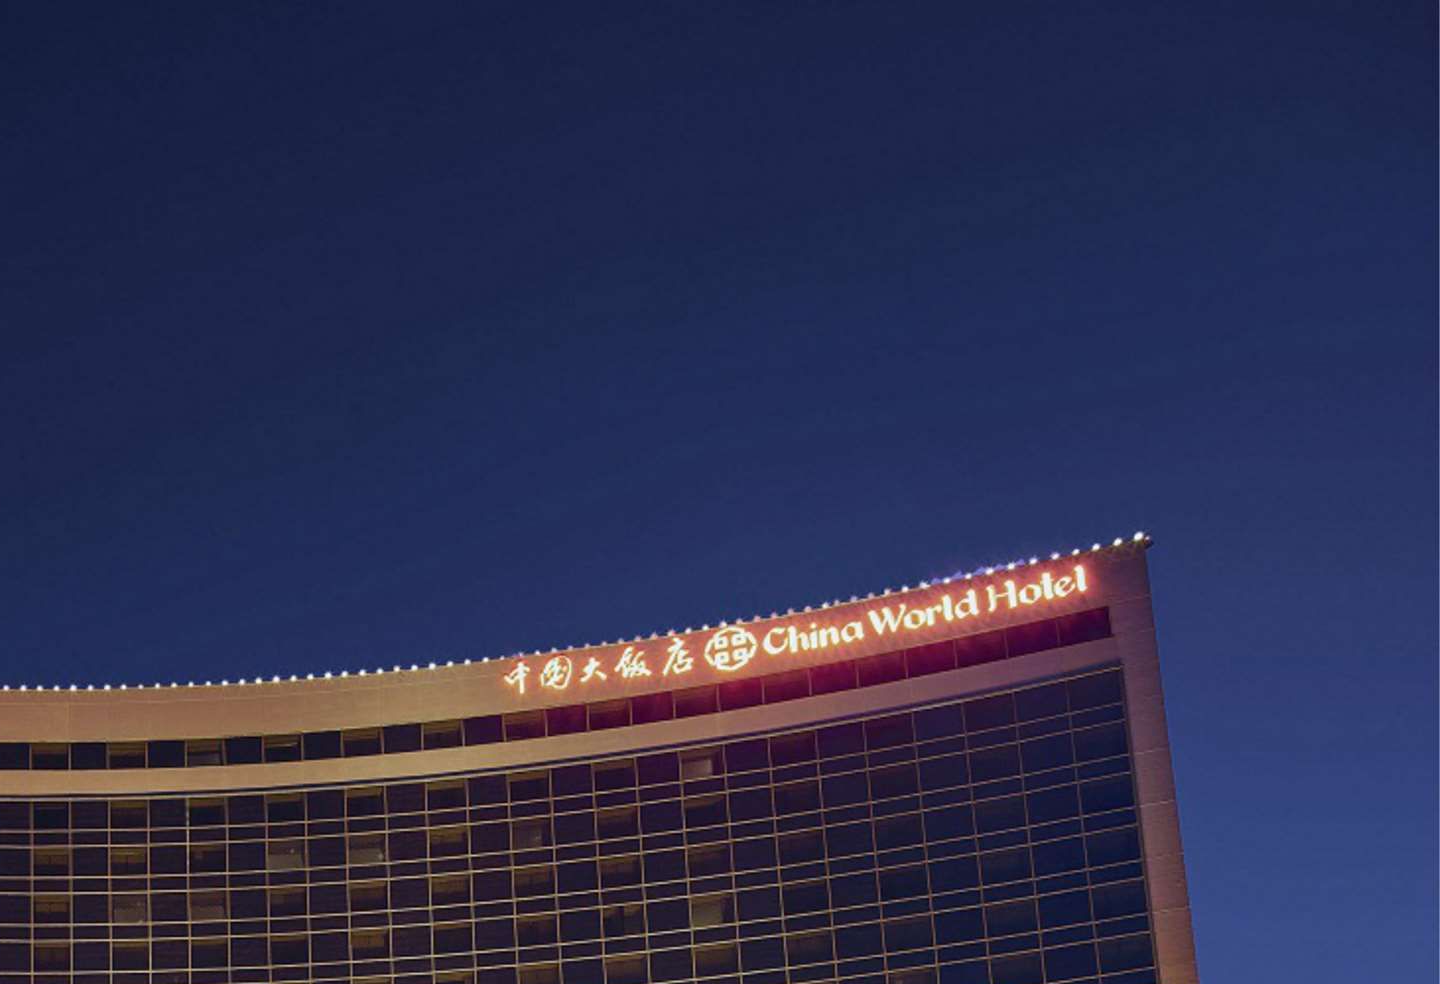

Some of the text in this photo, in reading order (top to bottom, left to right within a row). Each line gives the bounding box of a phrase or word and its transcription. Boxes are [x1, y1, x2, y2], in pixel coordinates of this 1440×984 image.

[762, 564, 1087, 656] China World Hotel
